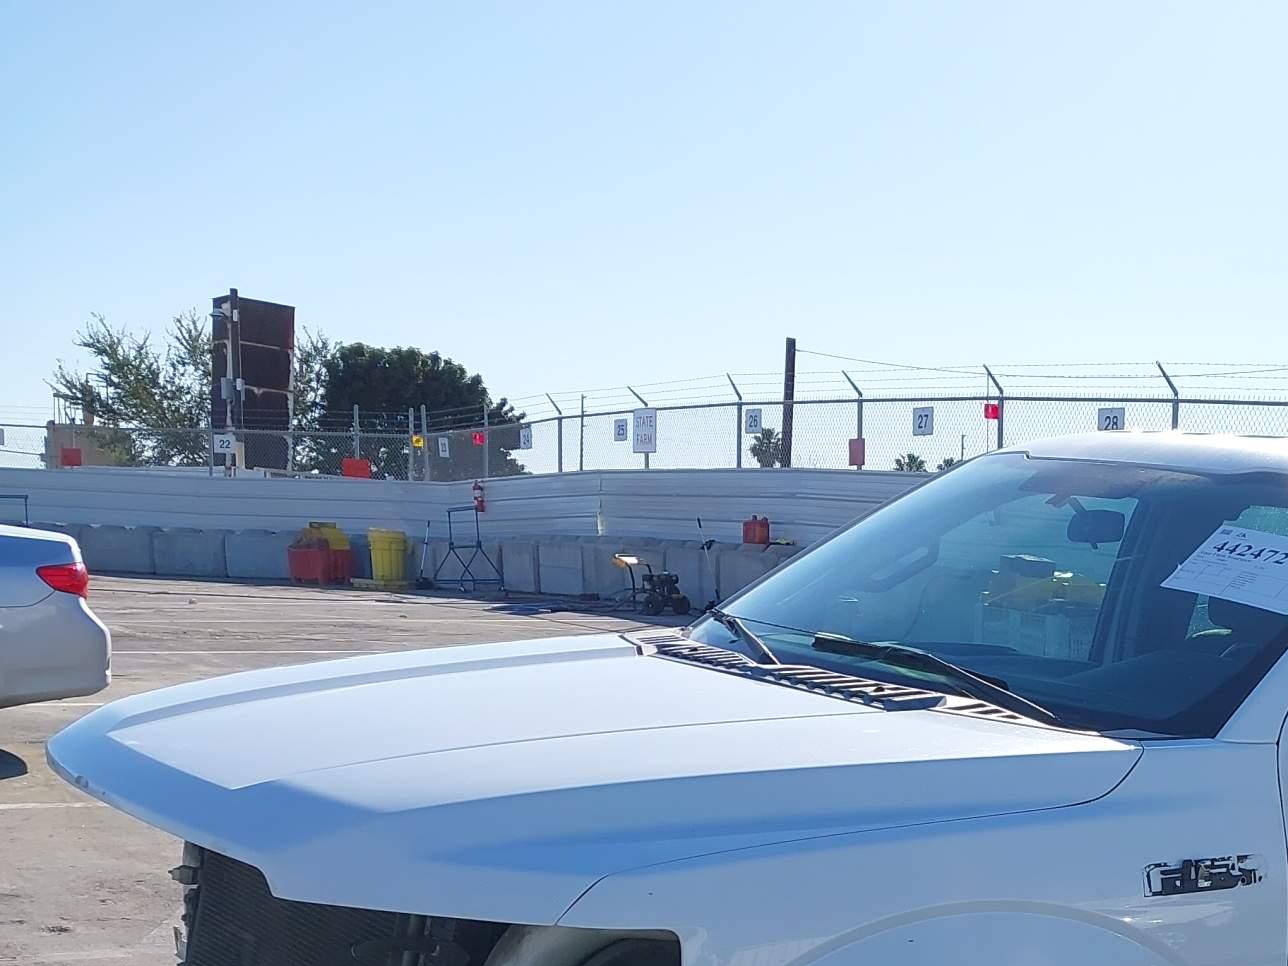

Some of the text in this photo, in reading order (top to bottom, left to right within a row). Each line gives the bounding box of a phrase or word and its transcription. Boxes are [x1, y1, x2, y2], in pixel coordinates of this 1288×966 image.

[635, 415, 654, 428] STATE
[749, 415, 758, 428] 26
[917, 414, 929, 429] 27
[1104, 415, 1119, 431] 28
[617, 424, 625, 437] 25
[219, 439, 231, 449] 22
